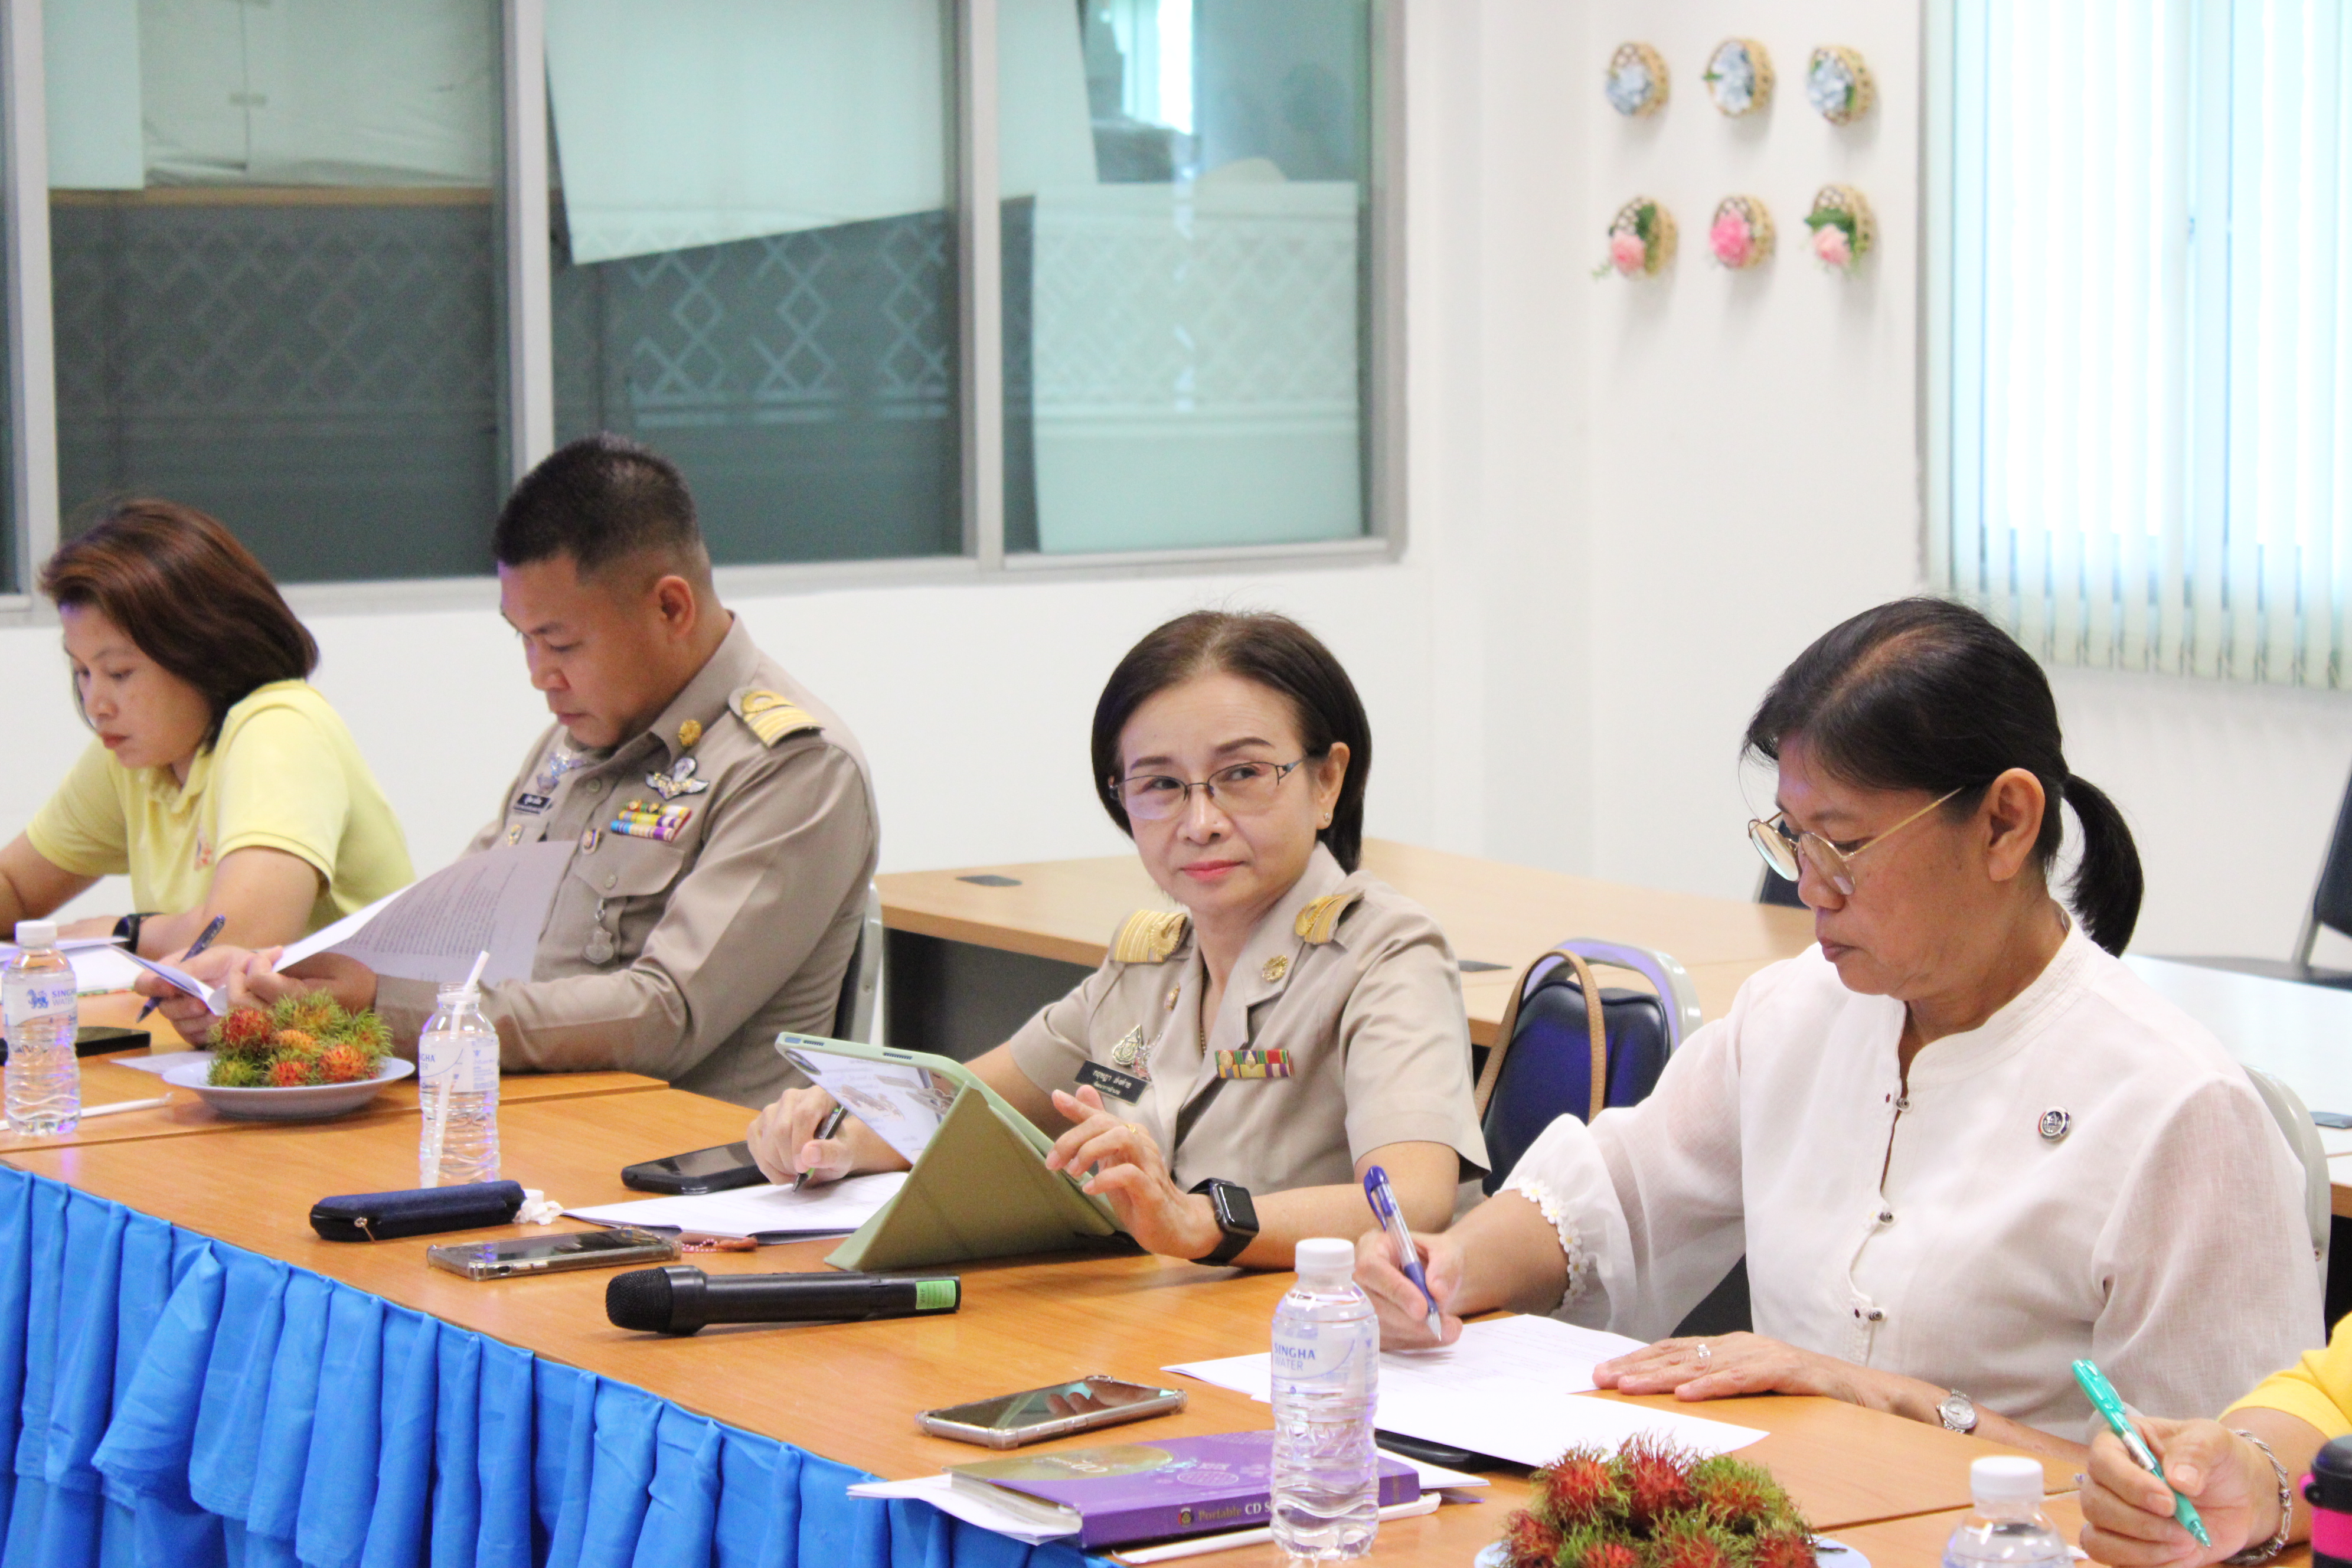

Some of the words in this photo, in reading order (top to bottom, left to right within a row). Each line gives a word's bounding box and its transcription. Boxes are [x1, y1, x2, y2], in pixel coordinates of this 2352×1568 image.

[1274, 1342, 1316, 1360] SINGHA
[1275, 1356, 1304, 1371] WATER
[1198, 1506, 1242, 1521] Portable
[1244, 1502, 1262, 1515] CD
